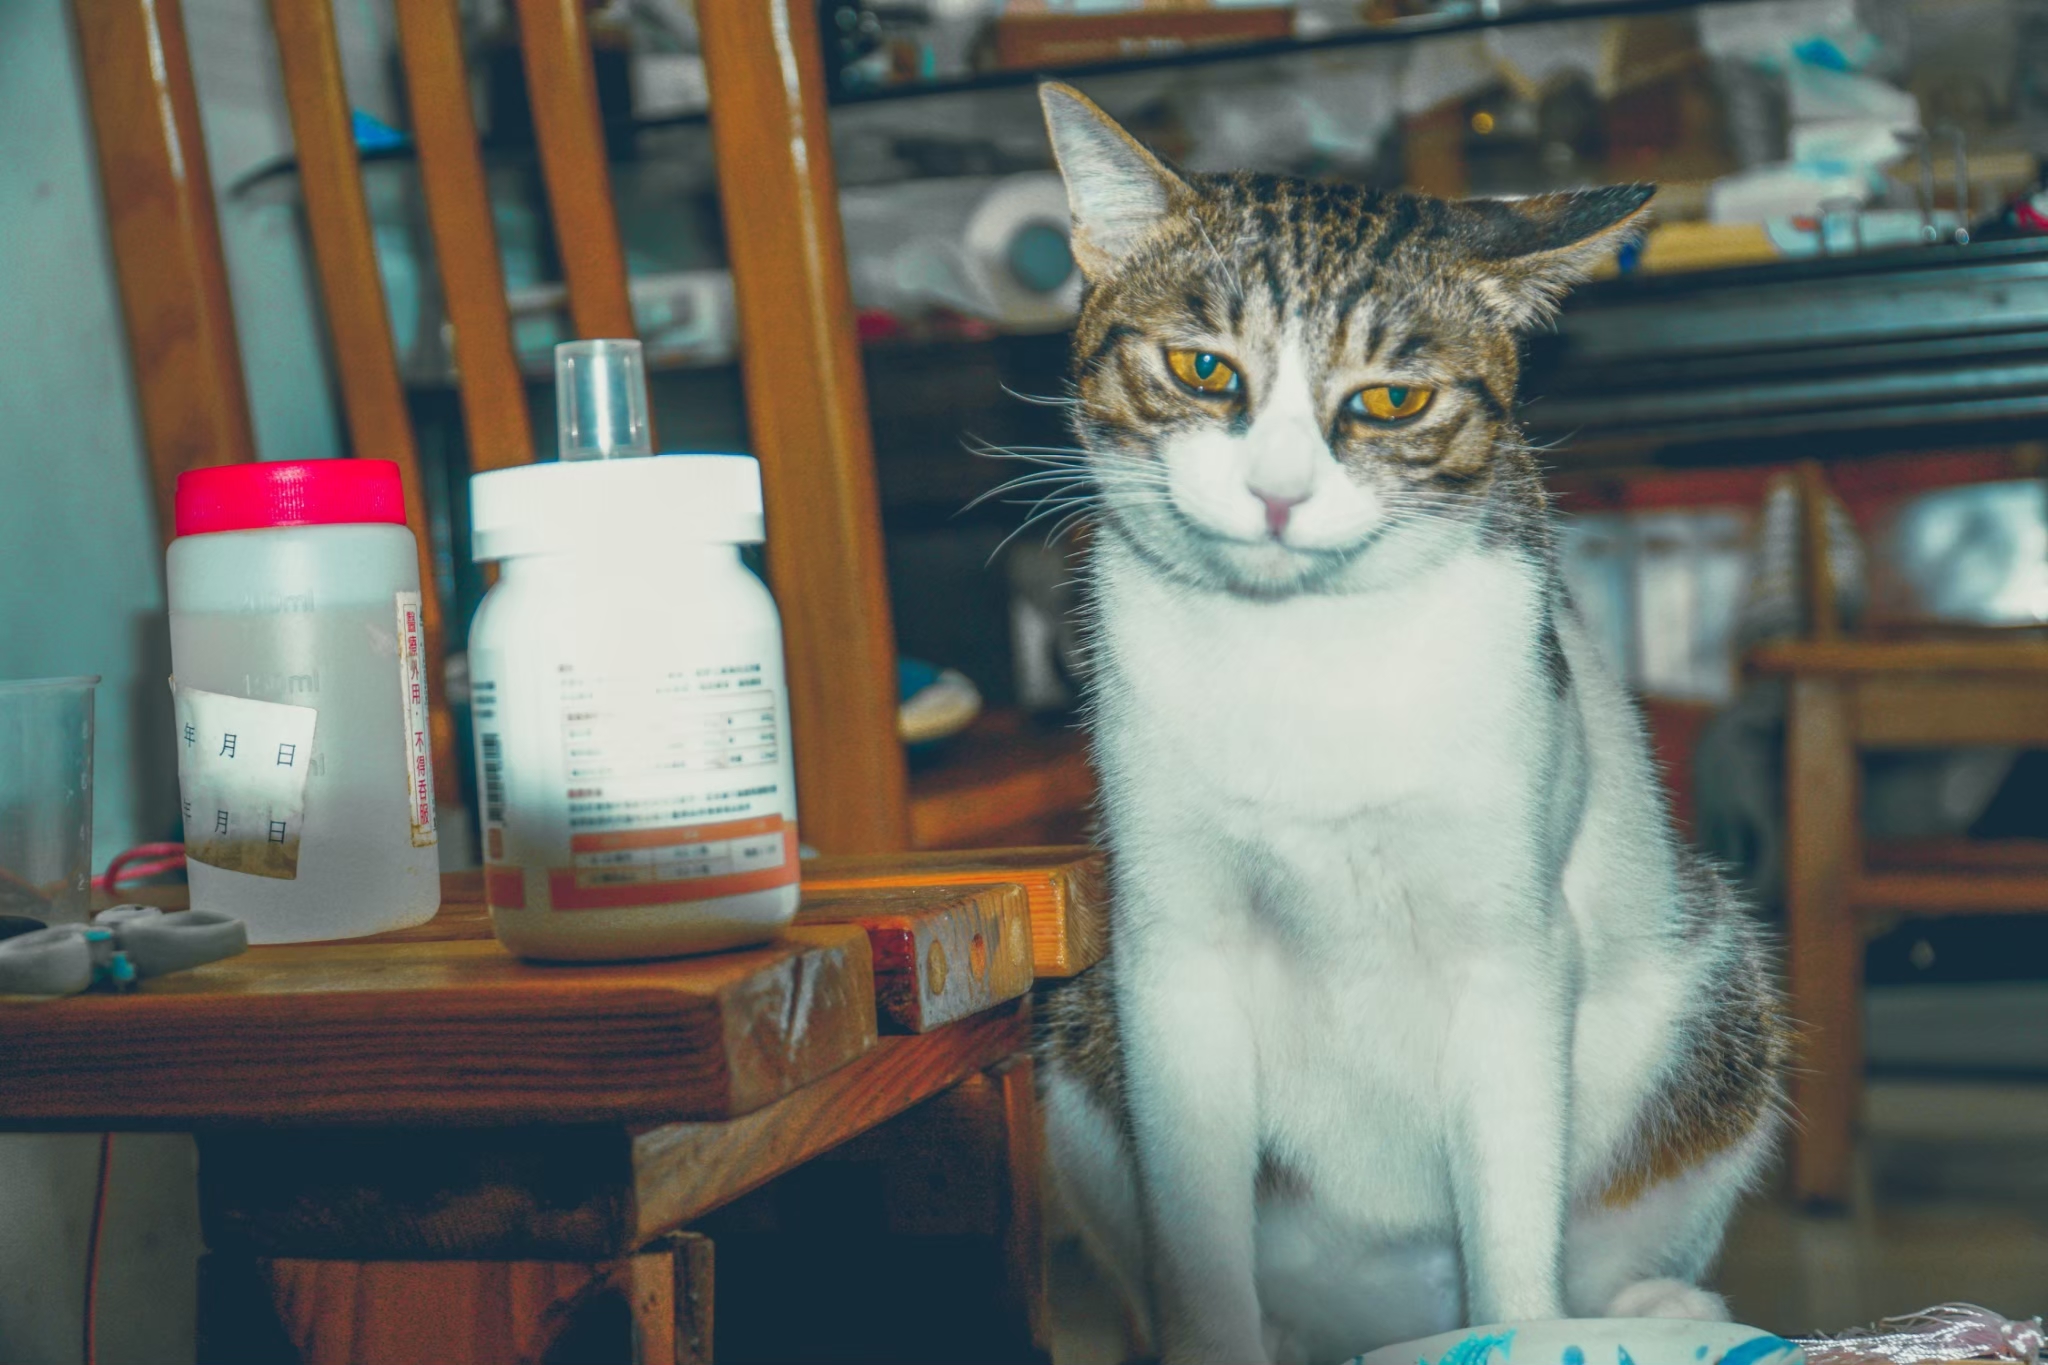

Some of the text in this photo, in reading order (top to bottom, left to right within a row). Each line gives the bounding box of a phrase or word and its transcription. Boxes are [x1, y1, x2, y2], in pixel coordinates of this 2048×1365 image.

[183, 722, 196, 748] 年
[219, 733, 237, 758] 月
[276, 743, 296, 767] 日
[214, 810, 229, 835] 月
[268, 820, 287, 844] 日
